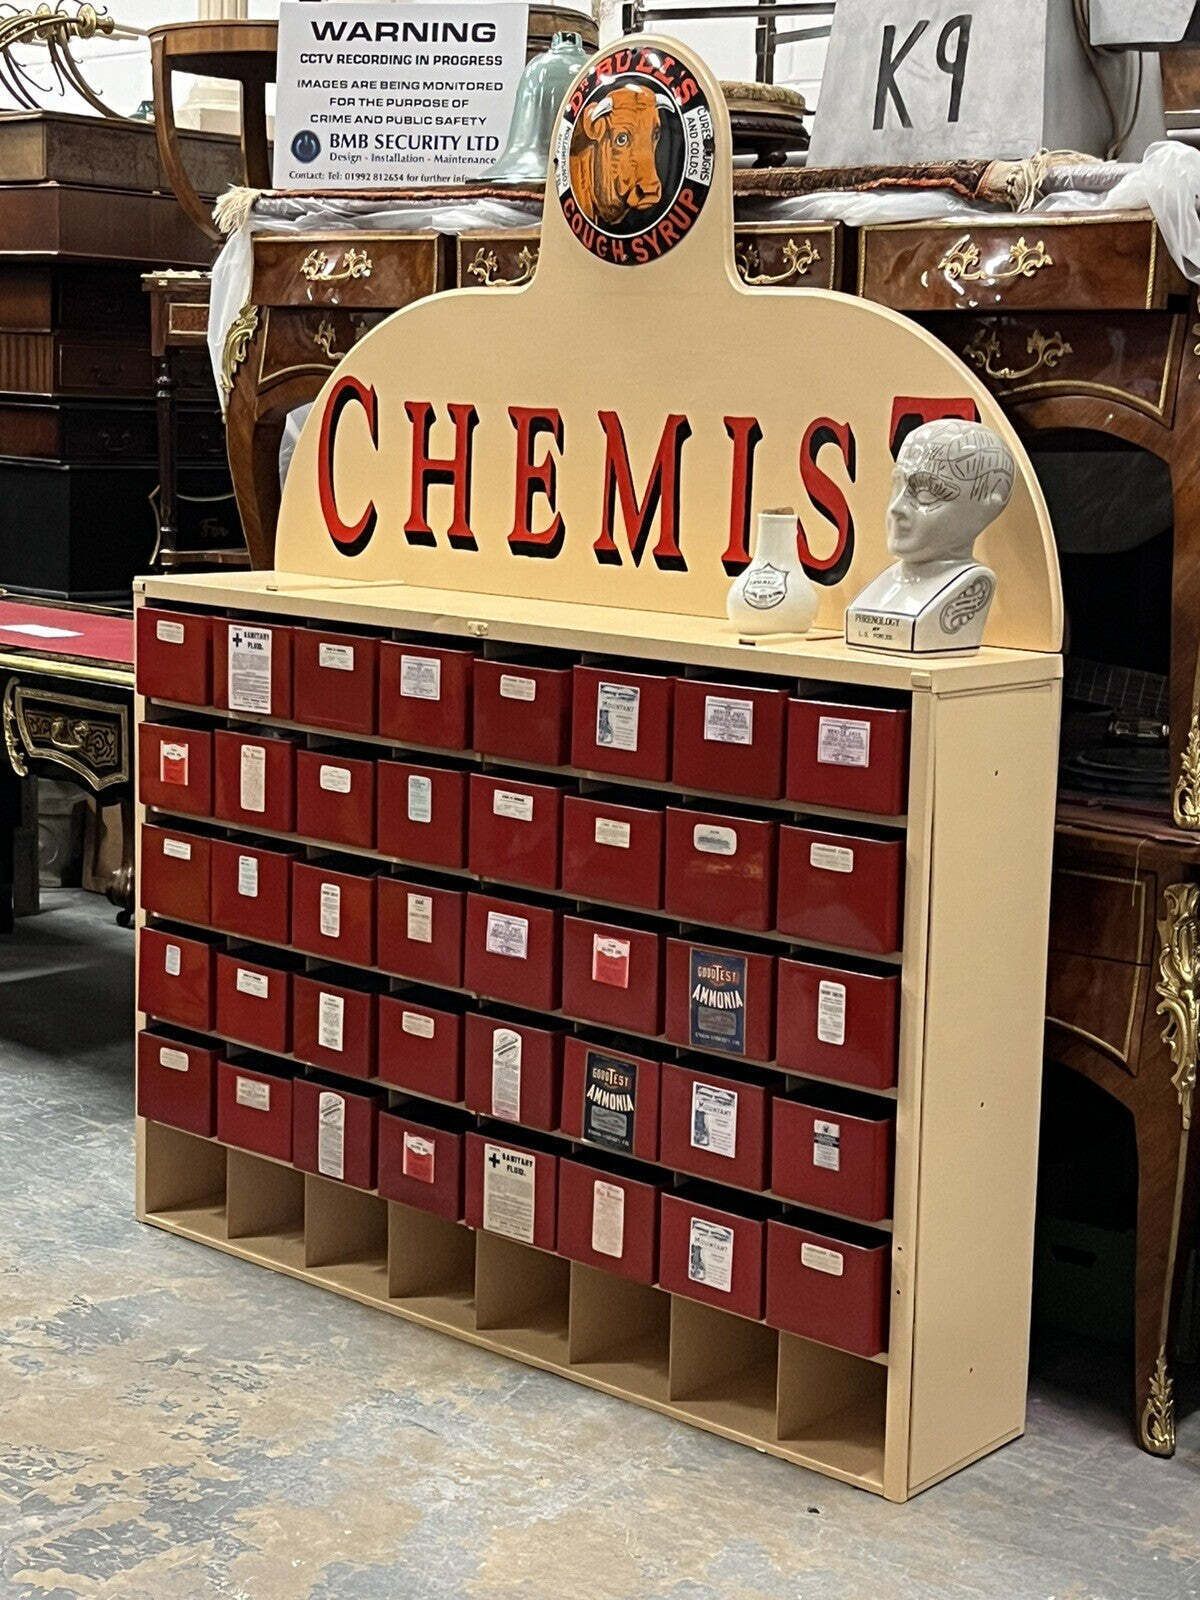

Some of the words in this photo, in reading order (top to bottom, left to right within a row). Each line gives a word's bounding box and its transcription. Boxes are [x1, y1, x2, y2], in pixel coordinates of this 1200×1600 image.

[311, 21, 496, 42] WARNING
[300, 53, 334, 64] CCTV
[336, 54, 412, 65] RECORDING
[415, 55, 429, 65] IN
[433, 55, 503, 66] PROGRESS
[872, 14, 973, 130] K9
[297, 80, 348, 89] IMAGES
[351, 80, 377, 90] ARE
[380, 81, 420, 90] BEING
[423, 82, 504, 91] MONITORED
[329, 97, 355, 106] FOR
[358, 98, 383, 107] THE
[386, 98, 449, 108] PURPOSE
[452, 99, 469, 108] OF
[310, 114, 352, 123] CRIME
[354, 115, 383, 124] AND
[386, 116, 433, 125] PUBLIC
[435, 117, 487, 126] SAFETY
[686, 117, 699, 139] AND
[697, 107, 711, 140] CURES
[329, 133, 368, 149] BMB
[374, 134, 462, 151] SECURITY
[466, 135, 499, 151] LTD
[329, 152, 362, 164] Design
[371, 153, 425, 163] Installation
[434, 154, 497, 164] Maintenance
[289, 171, 325, 180] Contact:
[328, 172, 341, 180] Tel:
[345, 172, 371, 181] 01992
[373, 173, 403, 182] 812654
[406, 173, 418, 182] for
[421, 173, 450, 182] further
[563, 197, 627, 262] COUGH
[631, 188, 699, 262] SYRUP
[692, 984, 743, 1009] AMMONIA
[586, 1084, 635, 1112] AMMONIA
